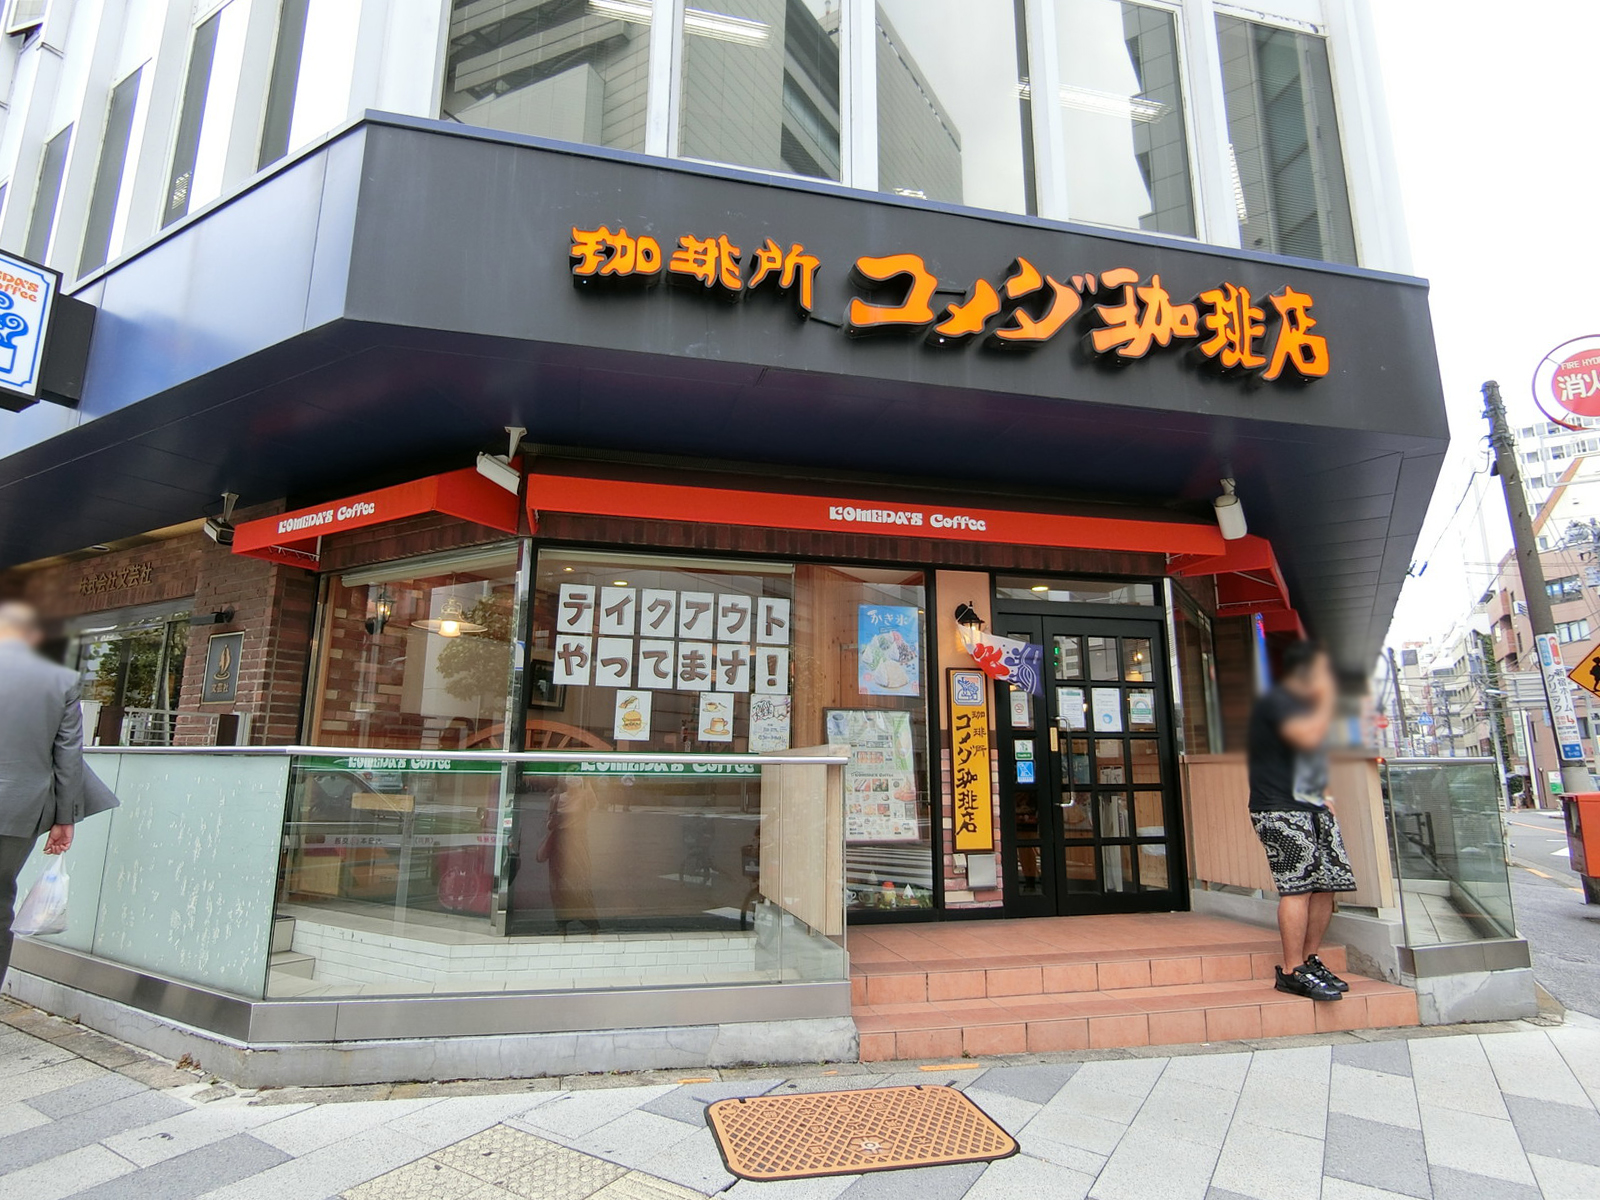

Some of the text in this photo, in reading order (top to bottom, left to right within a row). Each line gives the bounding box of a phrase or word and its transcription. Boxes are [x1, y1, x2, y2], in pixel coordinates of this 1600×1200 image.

[571, 226, 1330, 381] 珈琲所 コメダ珈琲店
[1561, 356, 1600, 370] FIRE HYD
[277, 501, 375, 535] KOMEDA'S Coffee
[828, 506, 987, 532] KOMEDA'S Coffee
[563, 592, 786, 638] テイクアウト
[954, 713, 980, 837] コメダ珈琲店
